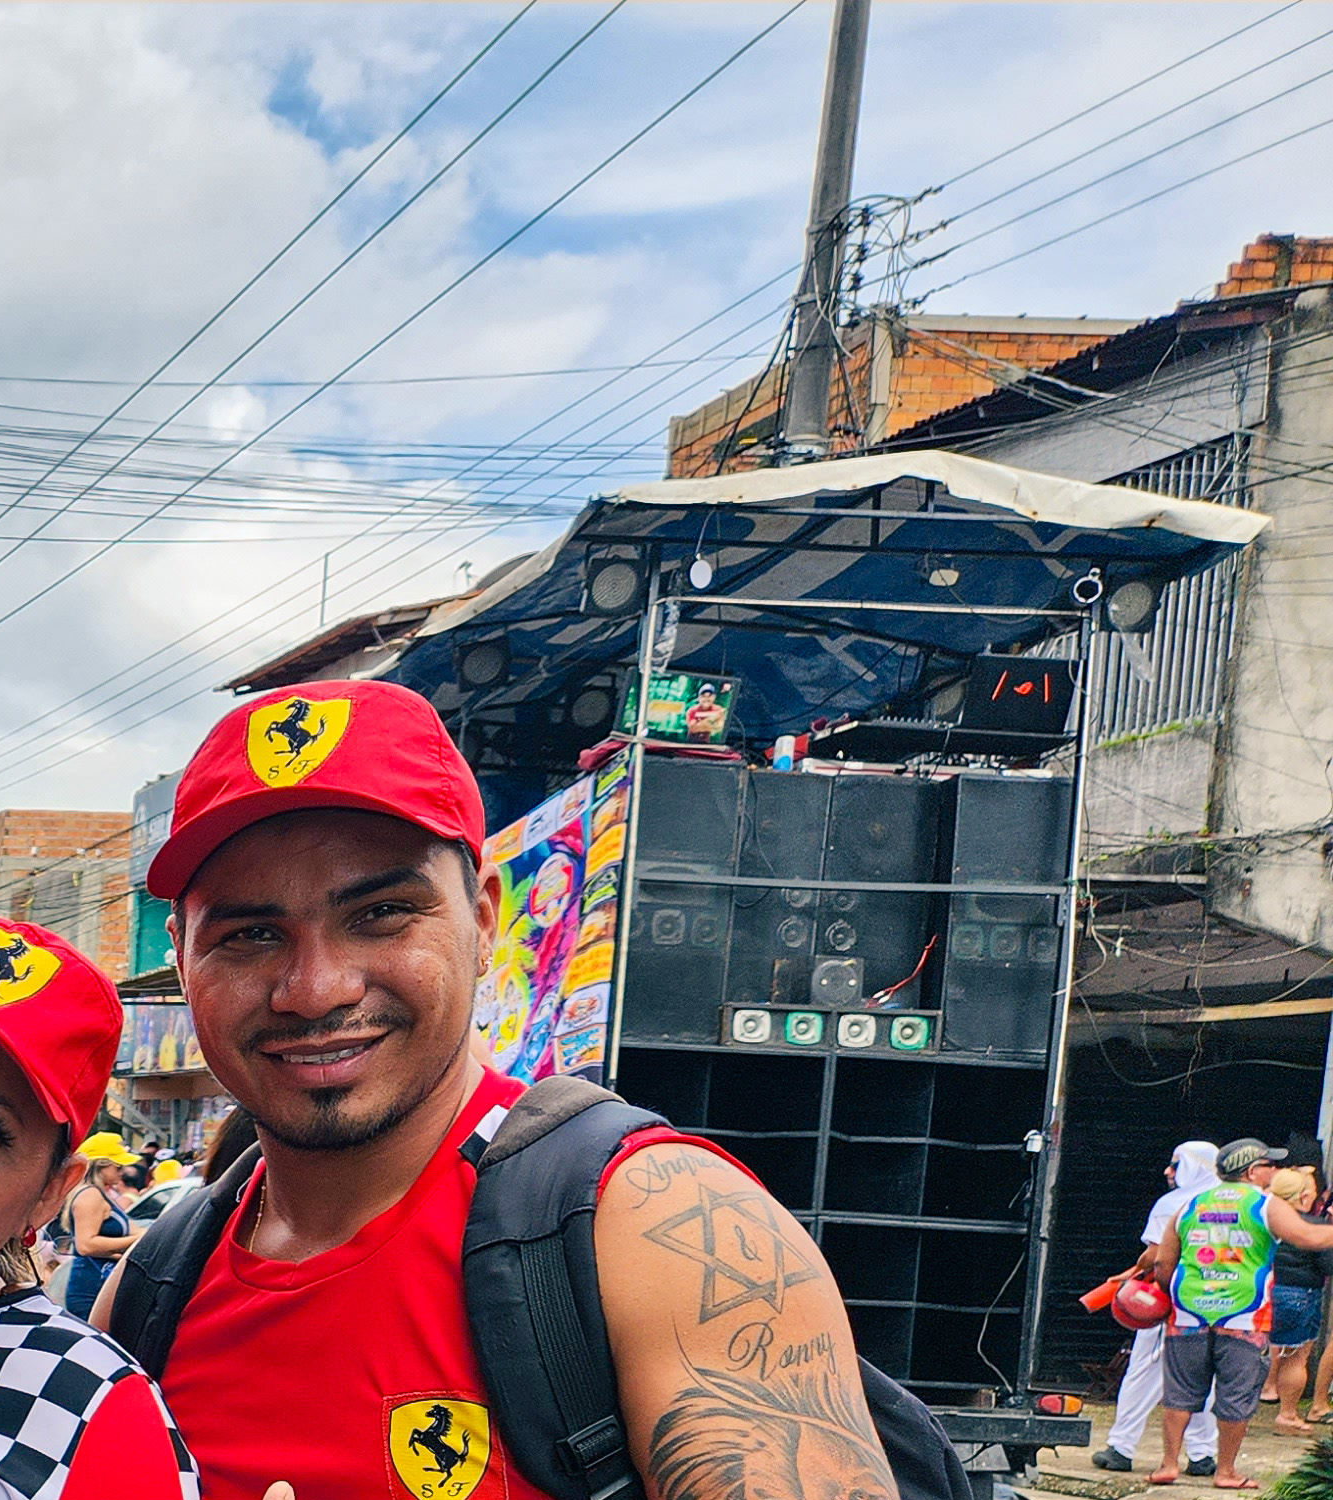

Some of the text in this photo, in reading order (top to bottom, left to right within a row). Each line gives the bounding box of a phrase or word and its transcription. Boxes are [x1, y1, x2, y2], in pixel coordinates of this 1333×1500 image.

[267, 764, 281, 781] S
[420, 1481, 472, 1499] S F
